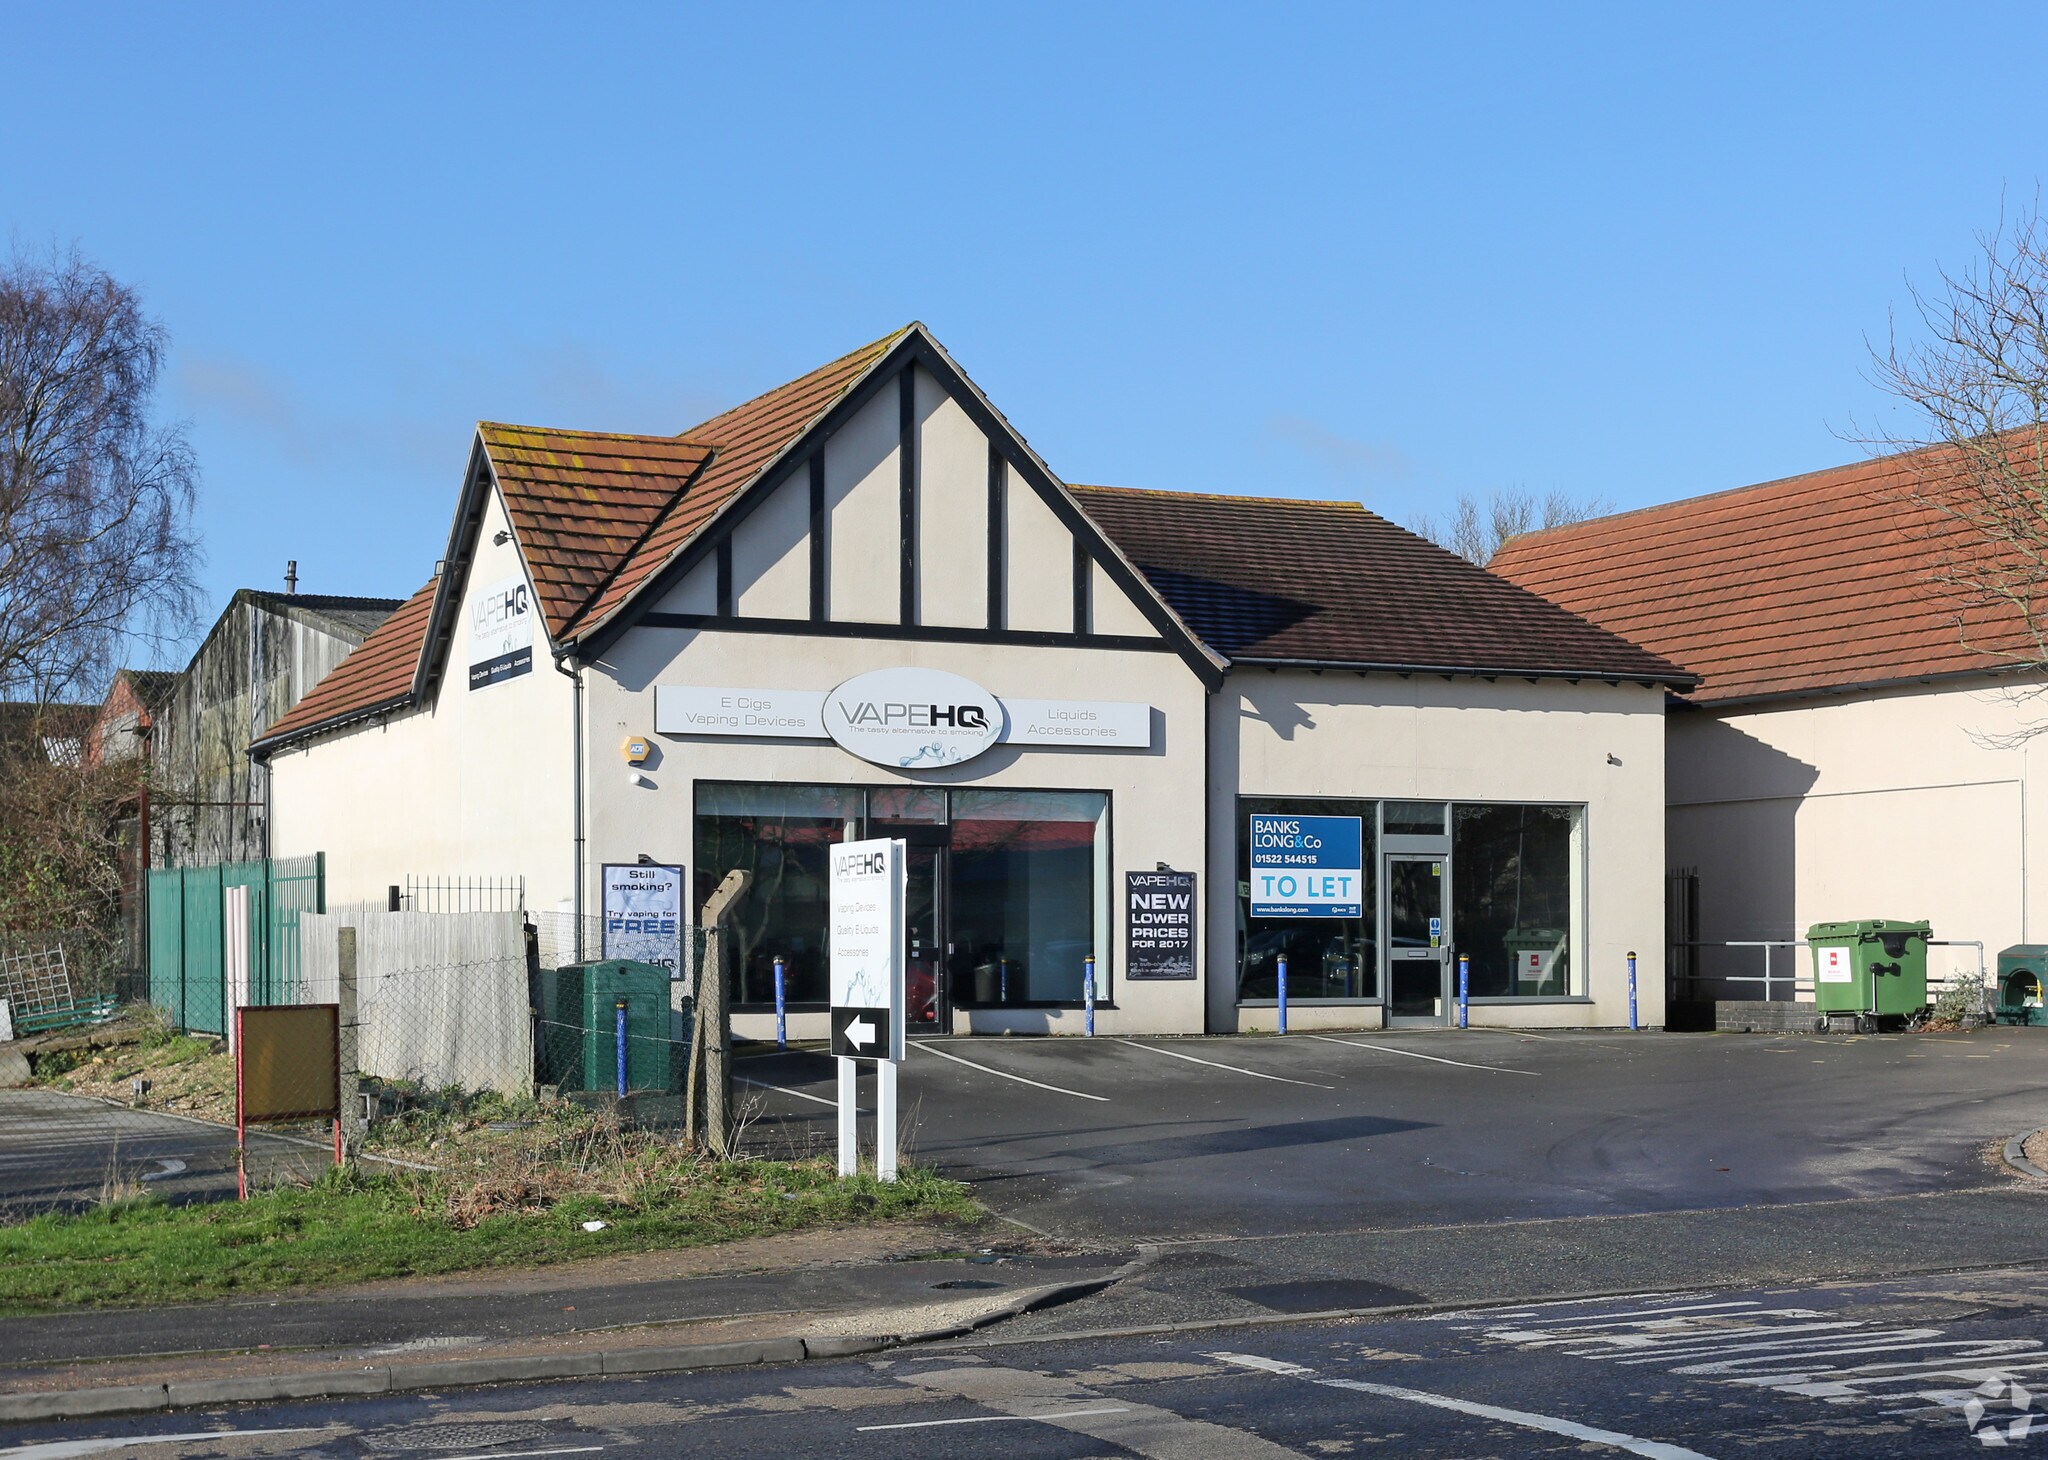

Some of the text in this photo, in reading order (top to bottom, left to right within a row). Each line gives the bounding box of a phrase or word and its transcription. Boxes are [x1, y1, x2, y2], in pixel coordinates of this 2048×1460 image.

[471, 584, 529, 631] VAPEHQ
[721, 697, 772, 711] E Cigs
[685, 712, 806, 727] Vaping Devices
[838, 701, 991, 732] VAPEHQ
[1048, 709, 1097, 721] Liquids
[892, 727, 936, 735] alternative
[950, 729, 984, 737] smoking
[1027, 724, 1117, 737] Accessories
[1255, 820, 1300, 834] BANKS
[1255, 834, 1322, 849] LONG&Co
[834, 852, 886, 876] VAPEHQ
[1255, 854, 1317, 864] 01522 544515
[629, 870, 655, 879] Still
[1129, 875, 1191, 887] VAPEHQ
[611, 882, 673, 892] smoking?
[1261, 875, 1352, 898] TO LET
[1131, 893, 1190, 910] NEW
[607, 910, 624, 918] Try
[627, 910, 659, 918] vaping
[1131, 913, 1189, 924] LOWER
[608, 919, 676, 934] FREE
[1132, 928, 1189, 938] PRICES
[1132, 940, 1189, 948] FOR 2017
